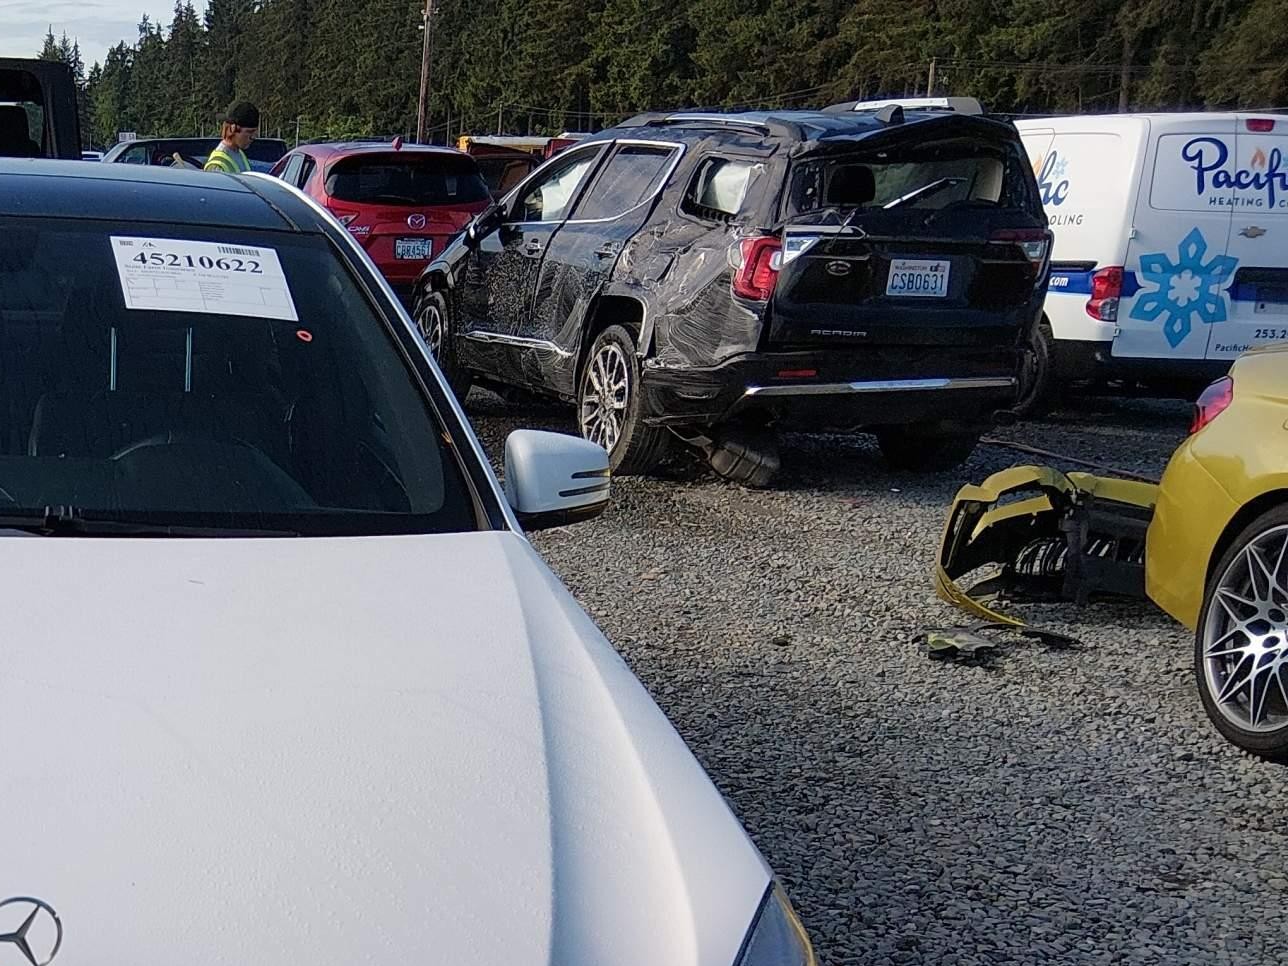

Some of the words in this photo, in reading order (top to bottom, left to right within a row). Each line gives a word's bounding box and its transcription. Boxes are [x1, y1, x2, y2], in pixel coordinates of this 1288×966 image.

[1182, 137, 1288, 209] Pacifi
[1209, 196, 1263, 207] HEATING
[1048, 214, 1084, 226] OLING
[133, 251, 263, 274] 45210622
[891, 273, 944, 291] CSB0631
[810, 329, 867, 337] ACADIA
